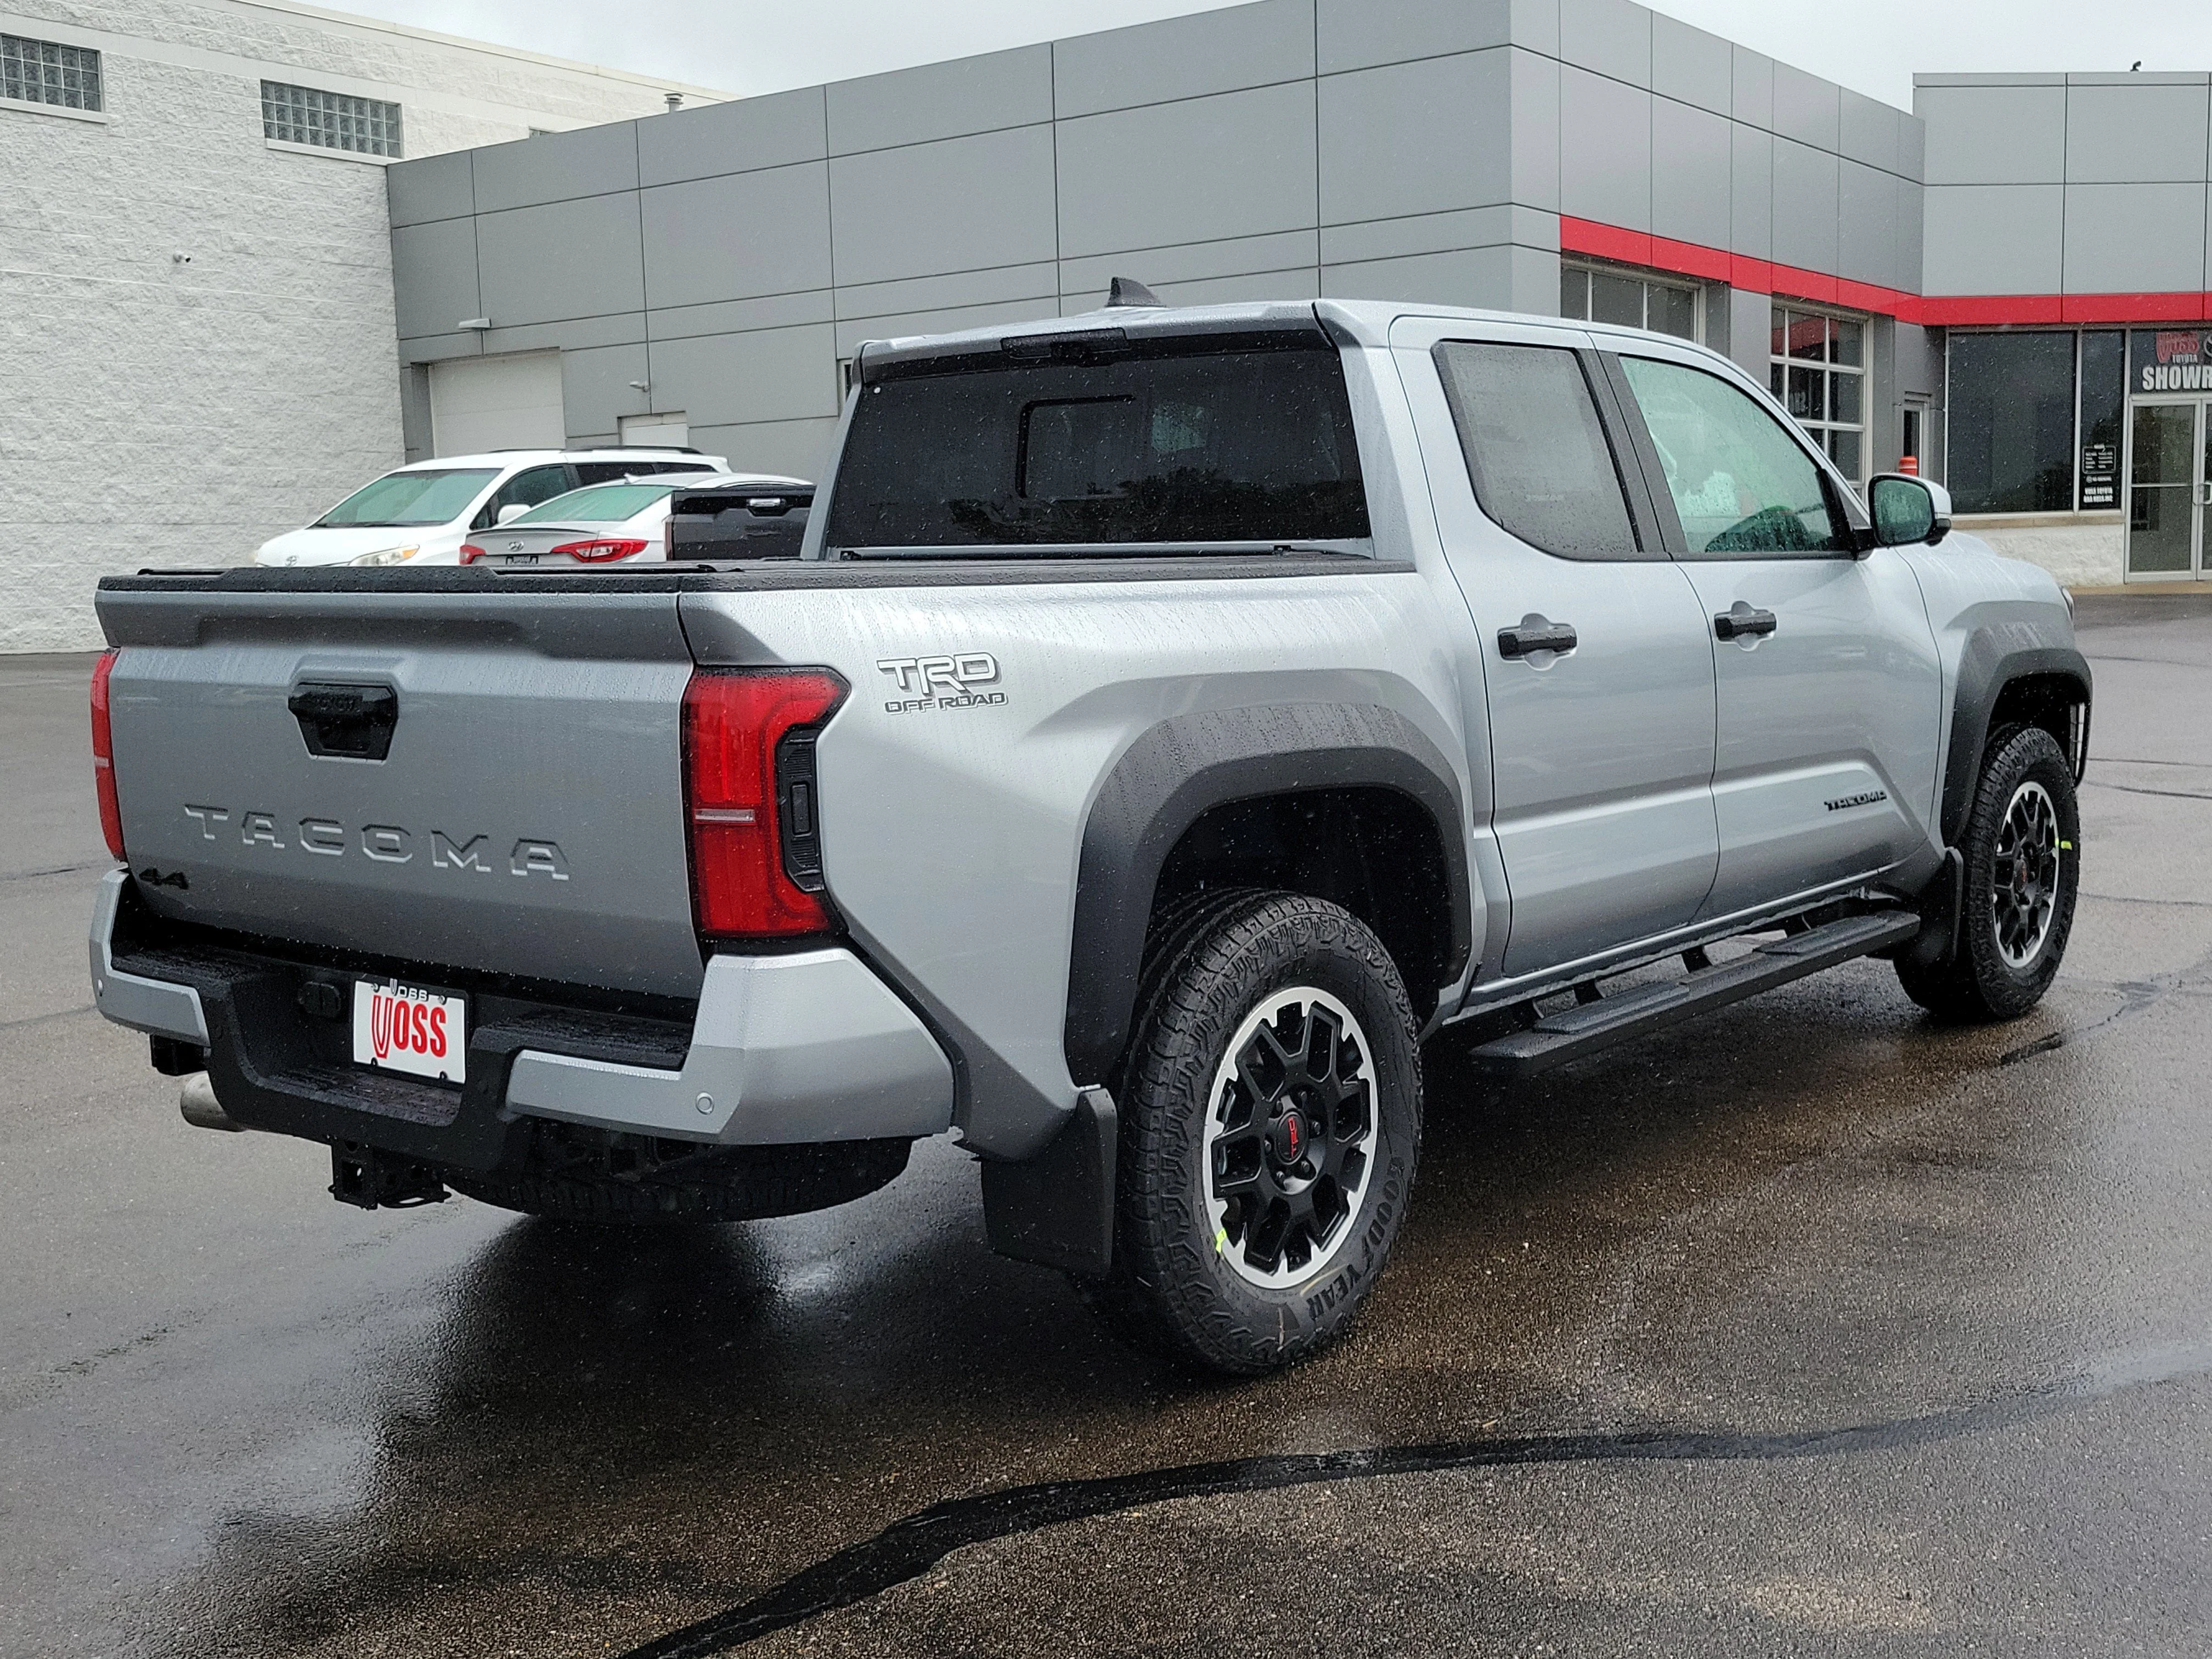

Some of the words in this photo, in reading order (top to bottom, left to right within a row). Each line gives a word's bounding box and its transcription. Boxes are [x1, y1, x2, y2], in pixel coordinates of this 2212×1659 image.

[2142, 365, 2212, 391] SHOWR
[876, 652, 1002, 697] TRD
[884, 697, 935, 714] OFF
[938, 692, 1008, 711] ROAD
[1824, 790, 1887, 811] TACOMA
[183, 803, 571, 881] TACOMA
[371, 994, 447, 1059] VOSS
